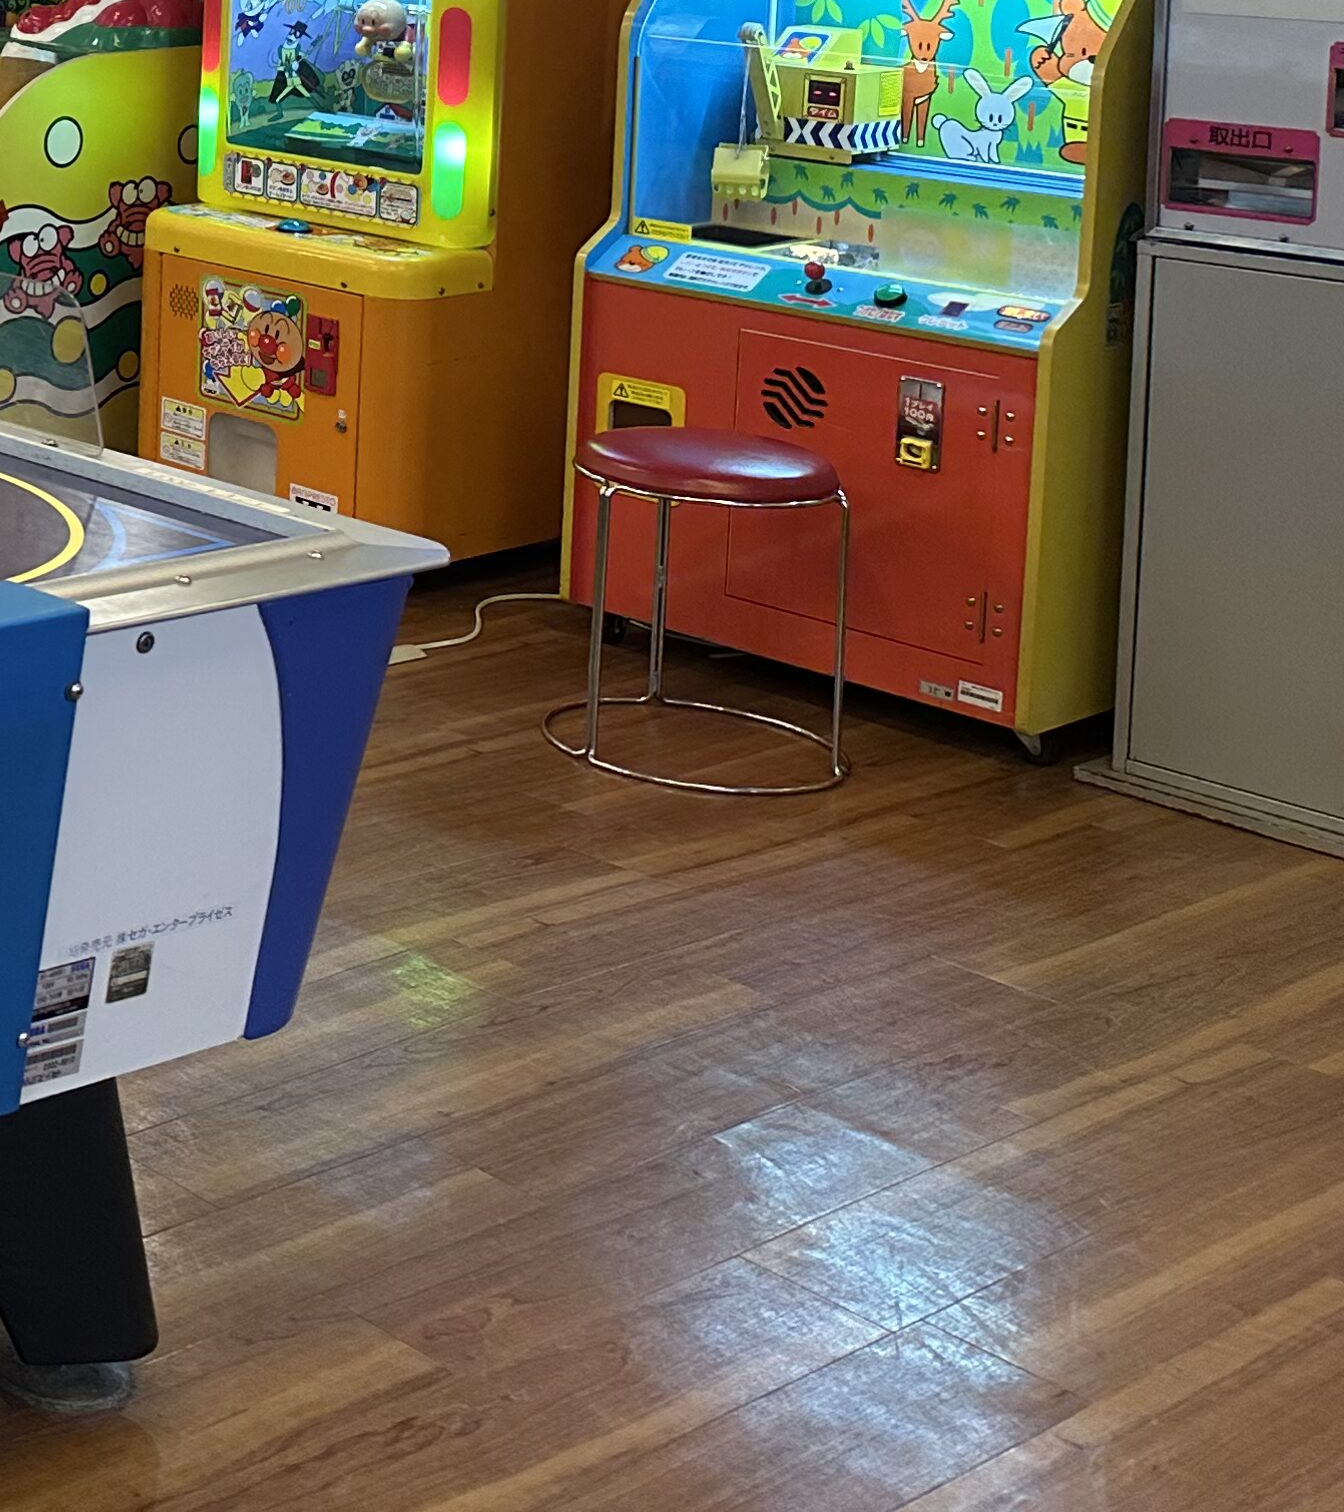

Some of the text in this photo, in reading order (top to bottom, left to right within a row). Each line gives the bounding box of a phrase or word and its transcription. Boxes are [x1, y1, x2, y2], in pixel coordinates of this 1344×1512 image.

[1208, 125, 1272, 150] 取出口
[904, 406, 935, 422] 100円
